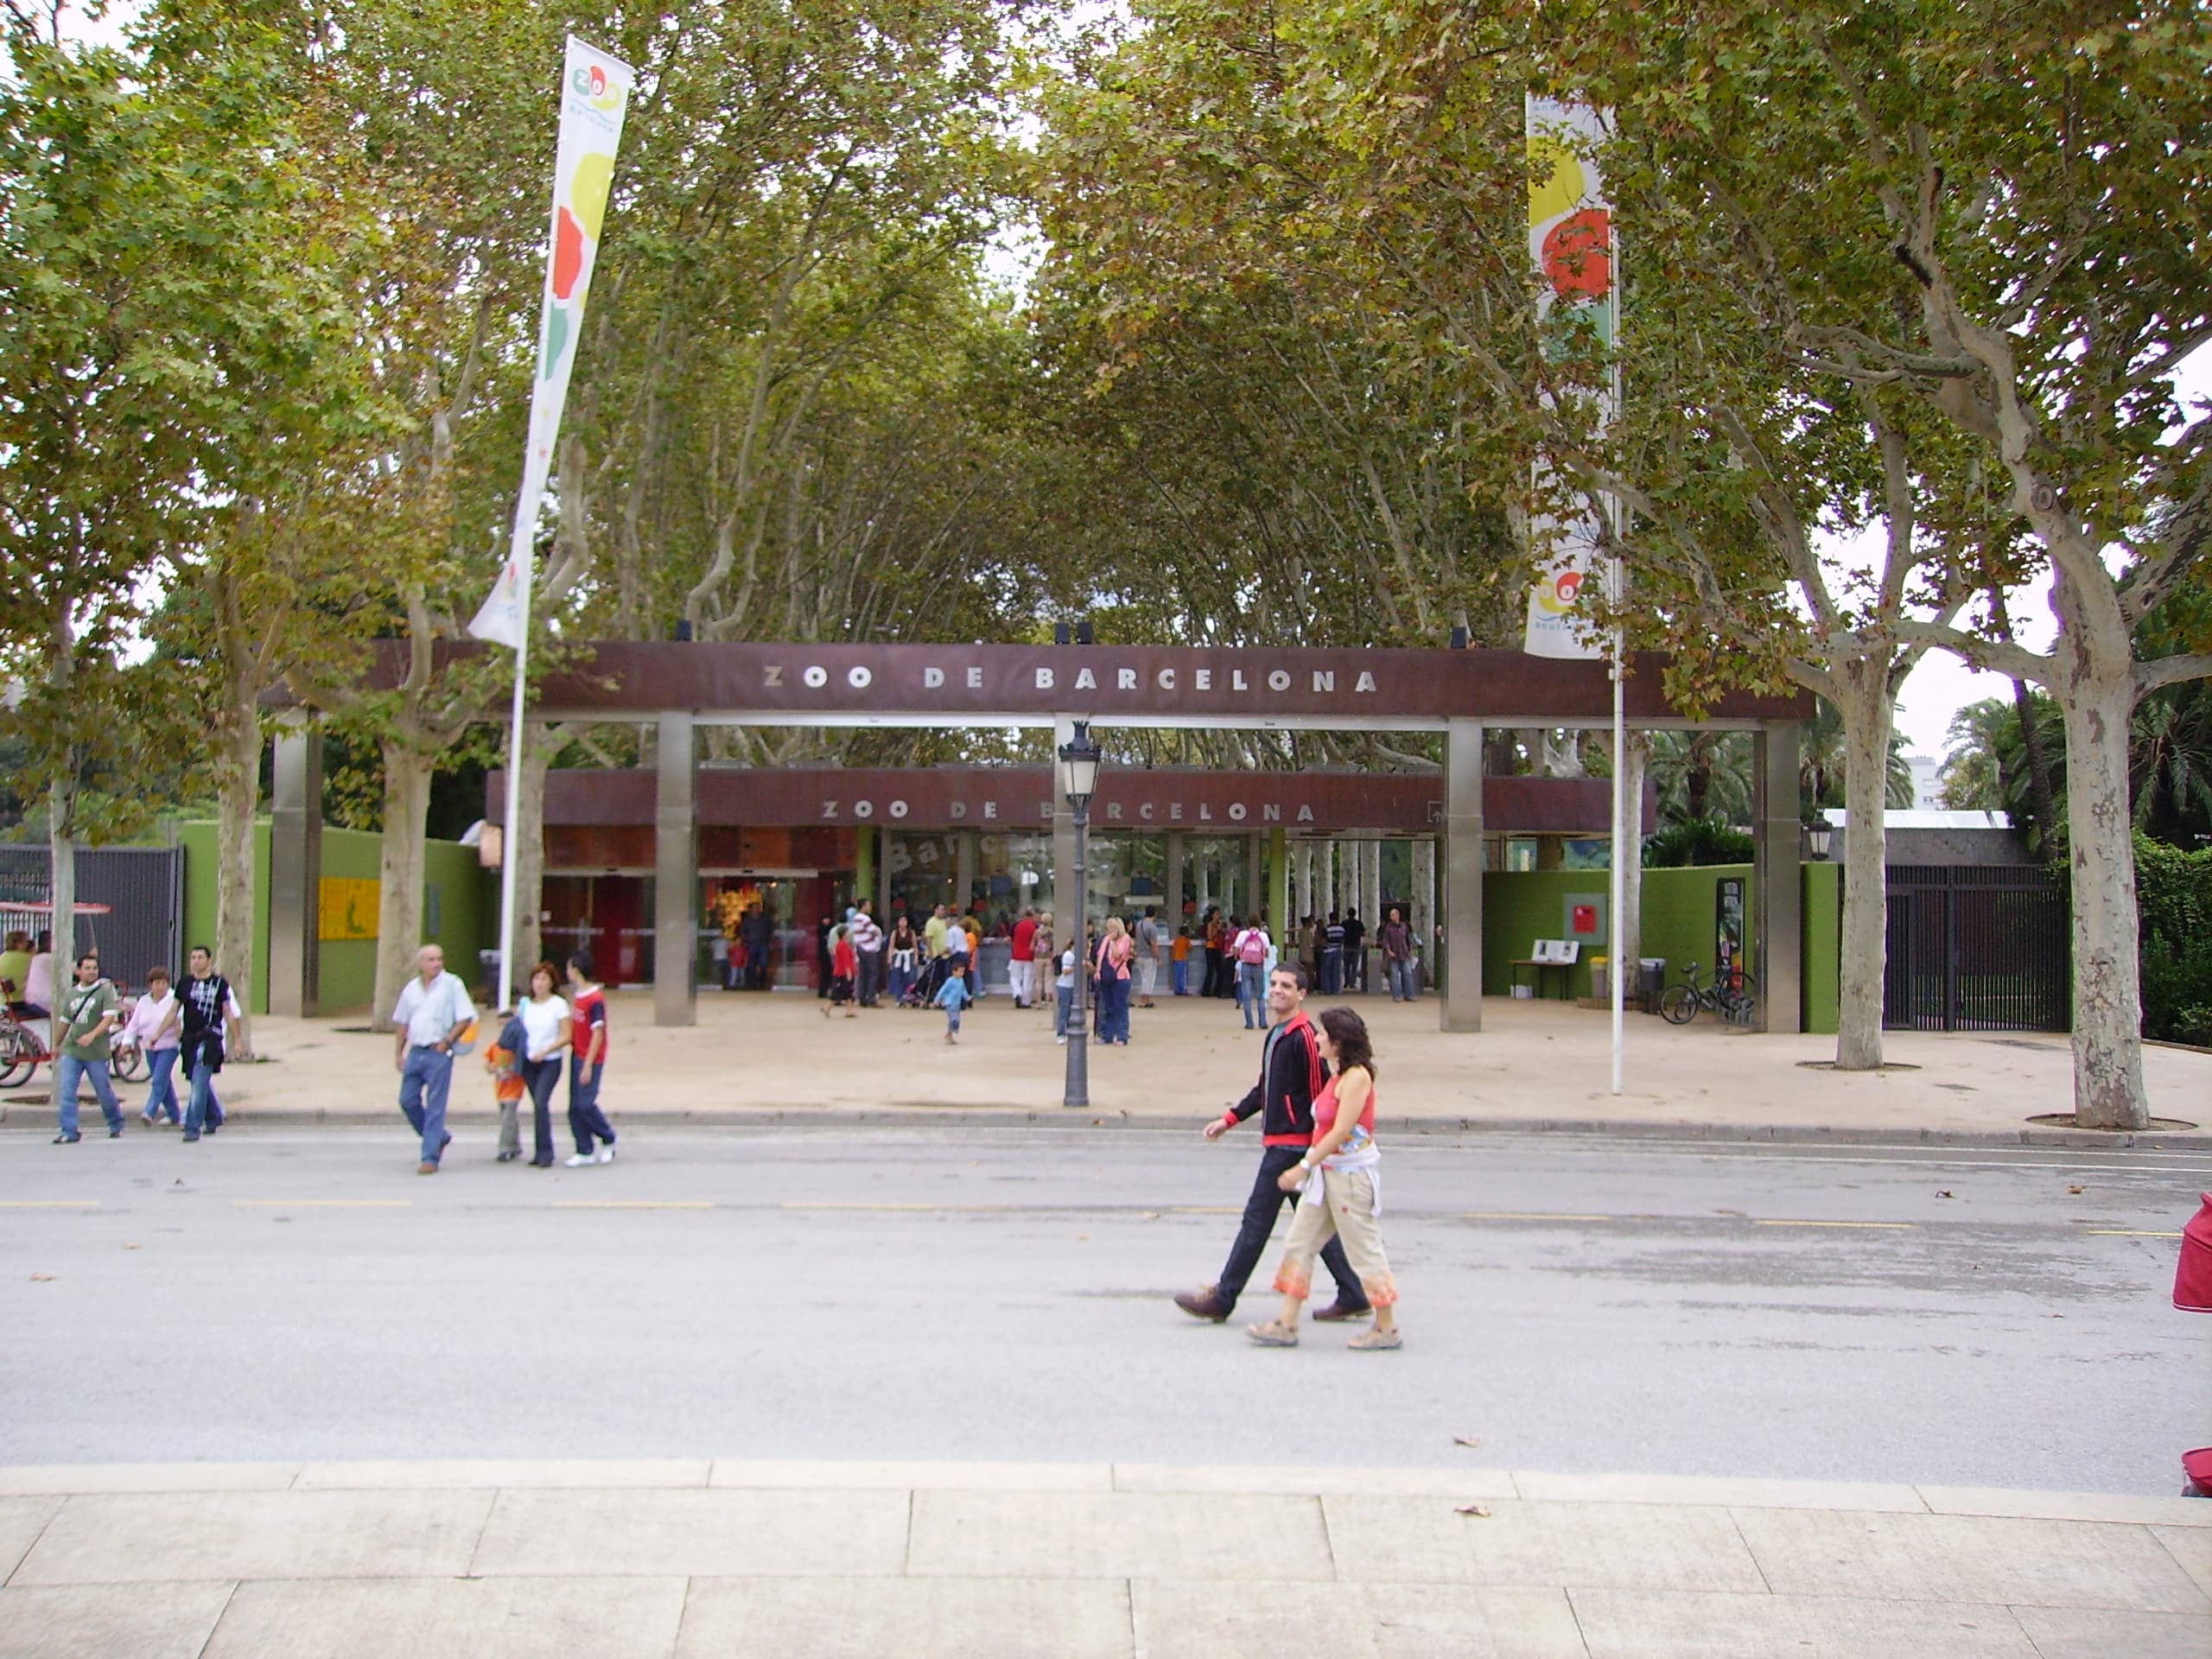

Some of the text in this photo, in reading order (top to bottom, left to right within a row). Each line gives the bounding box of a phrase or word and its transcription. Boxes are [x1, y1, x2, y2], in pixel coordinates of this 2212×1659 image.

[763, 664, 1377, 692] ZOO DE BARCELONA
[823, 799, 1314, 822] ZOO DE BRCELONA
